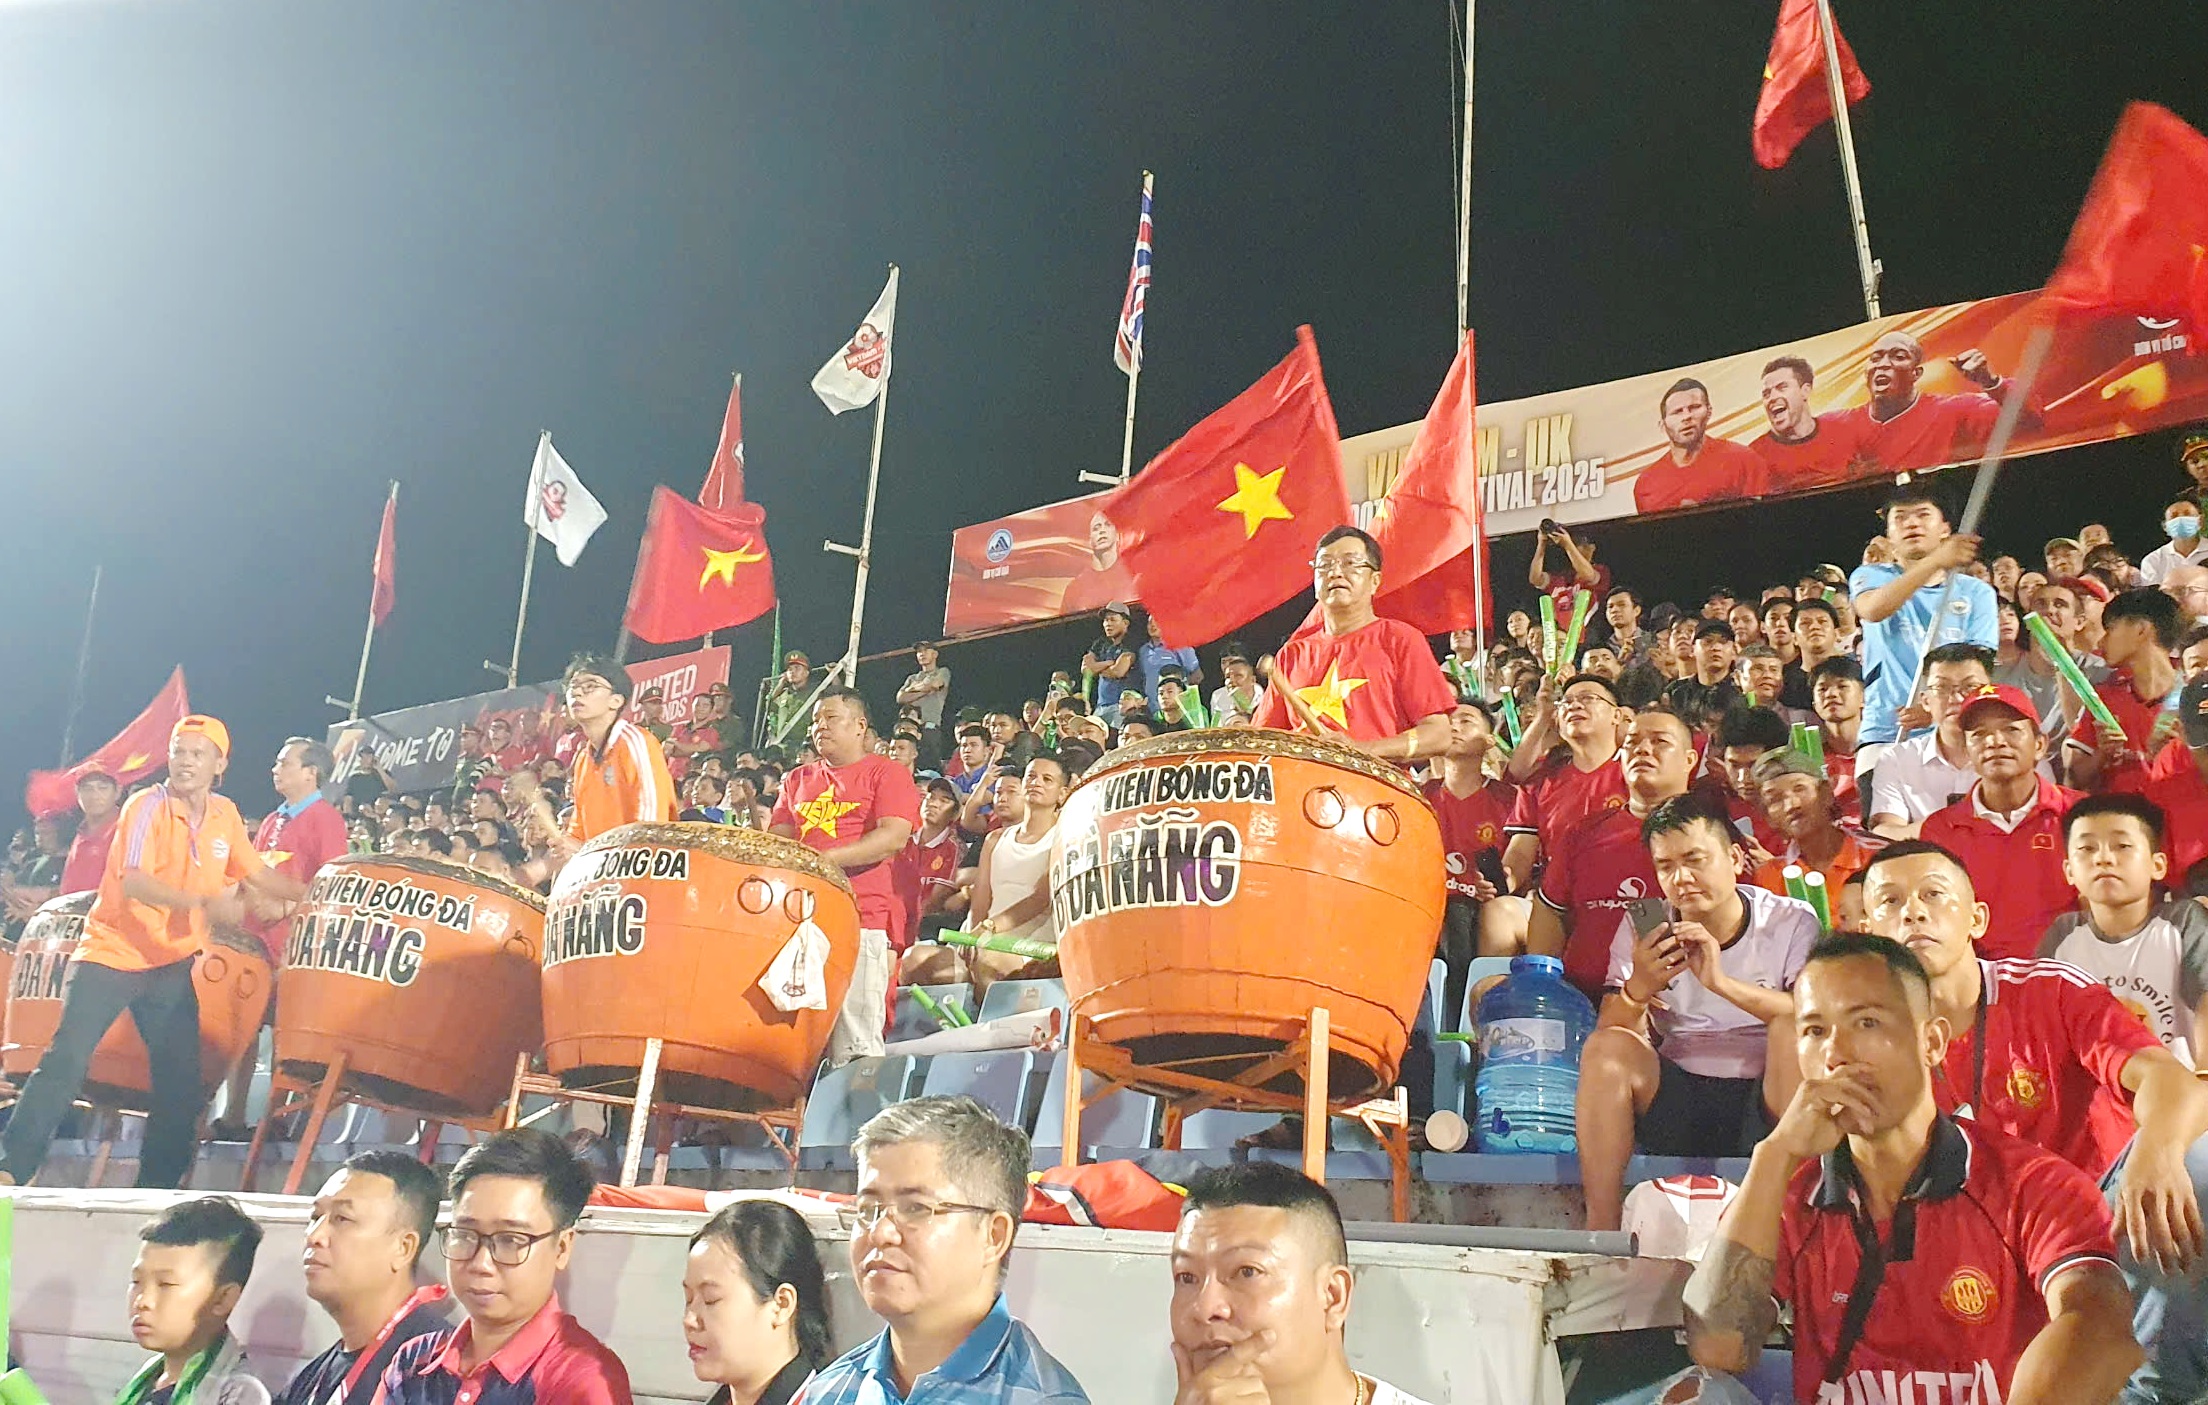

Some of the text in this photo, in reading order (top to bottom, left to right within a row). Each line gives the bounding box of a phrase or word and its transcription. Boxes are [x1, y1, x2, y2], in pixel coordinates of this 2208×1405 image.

[1526, 413, 1573, 474] UK
[1478, 469, 1536, 514] TIVAL
[1541, 458, 1605, 506] 2025
[631, 664, 698, 712] UTED
[424, 726, 455, 763] TO
[2131, 977, 2174, 1025] Smile
